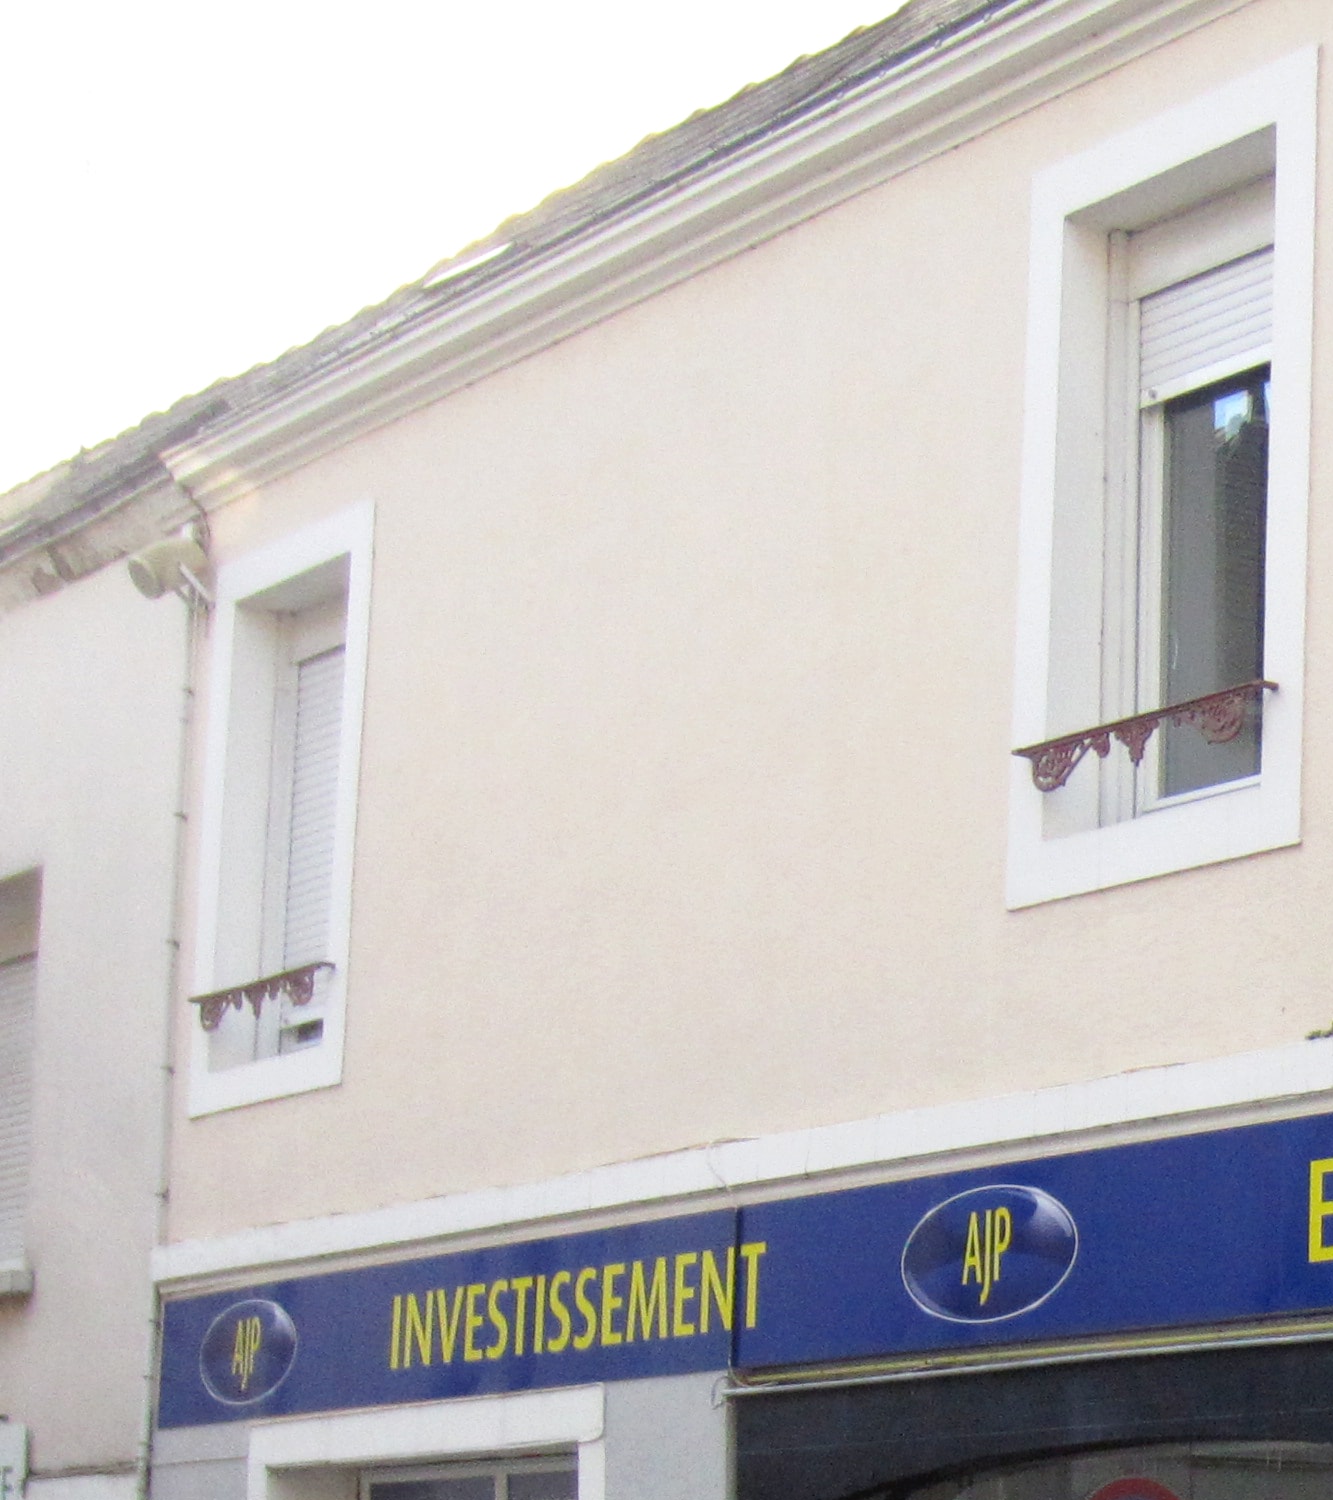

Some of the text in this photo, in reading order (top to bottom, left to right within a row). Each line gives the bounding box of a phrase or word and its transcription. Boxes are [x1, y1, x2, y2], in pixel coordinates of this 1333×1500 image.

[389, 1241, 766, 1370] INVESTISSEMENT
[961, 1204, 1011, 1306] AJP
[230, 1315, 263, 1391] AJP
